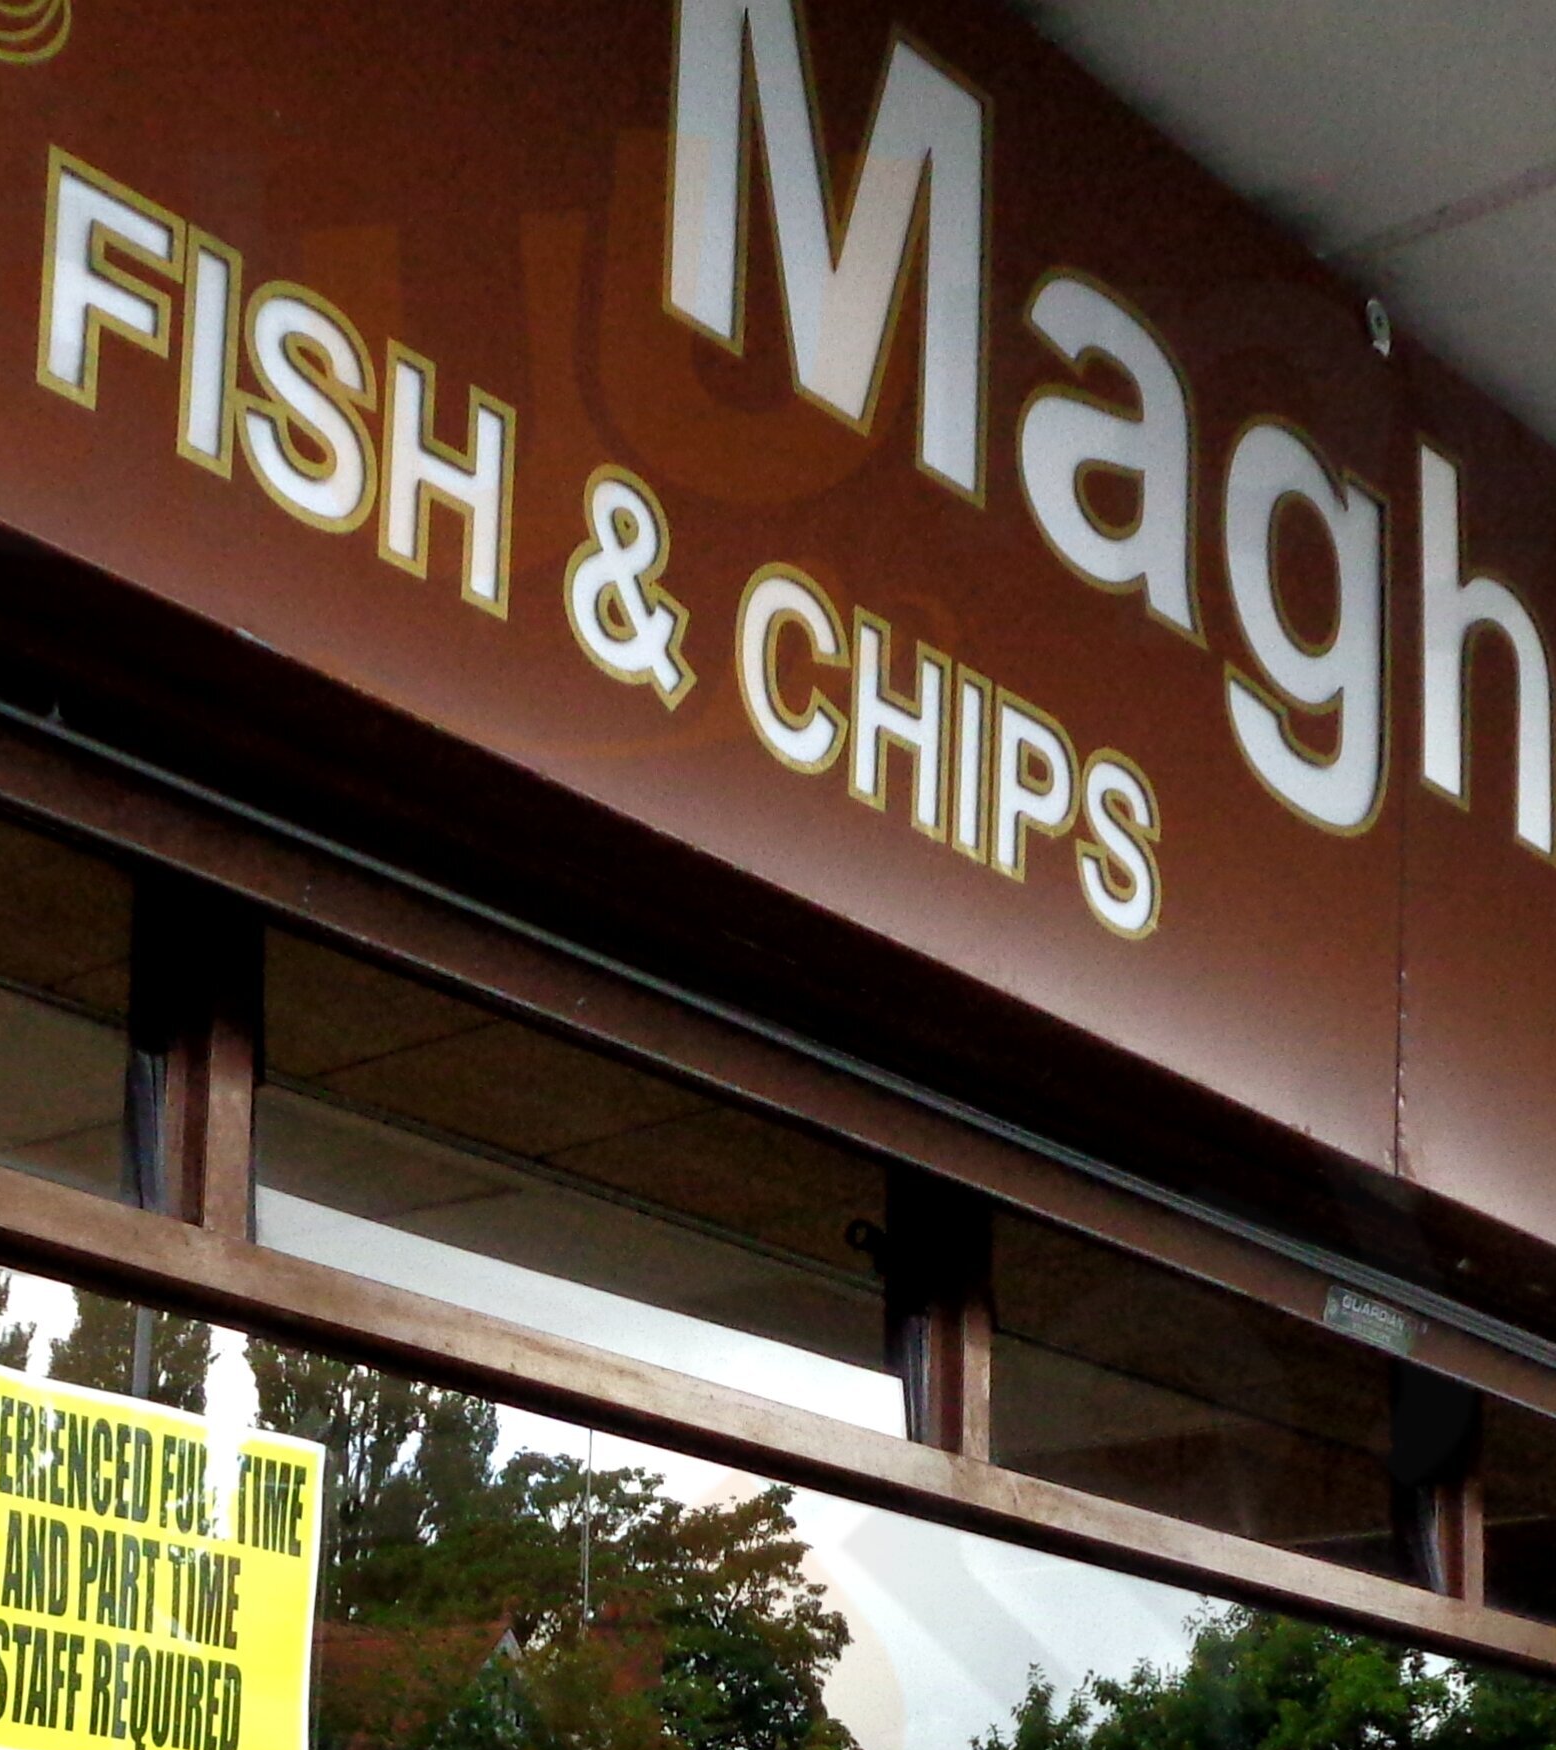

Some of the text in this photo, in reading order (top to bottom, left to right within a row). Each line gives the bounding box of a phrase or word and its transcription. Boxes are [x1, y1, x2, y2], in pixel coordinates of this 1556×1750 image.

[37, 143, 1161, 941] FISH & CHIPS
[236, 1454, 307, 1557] TIME
[1, 1510, 241, 1650] AND PART TIME
